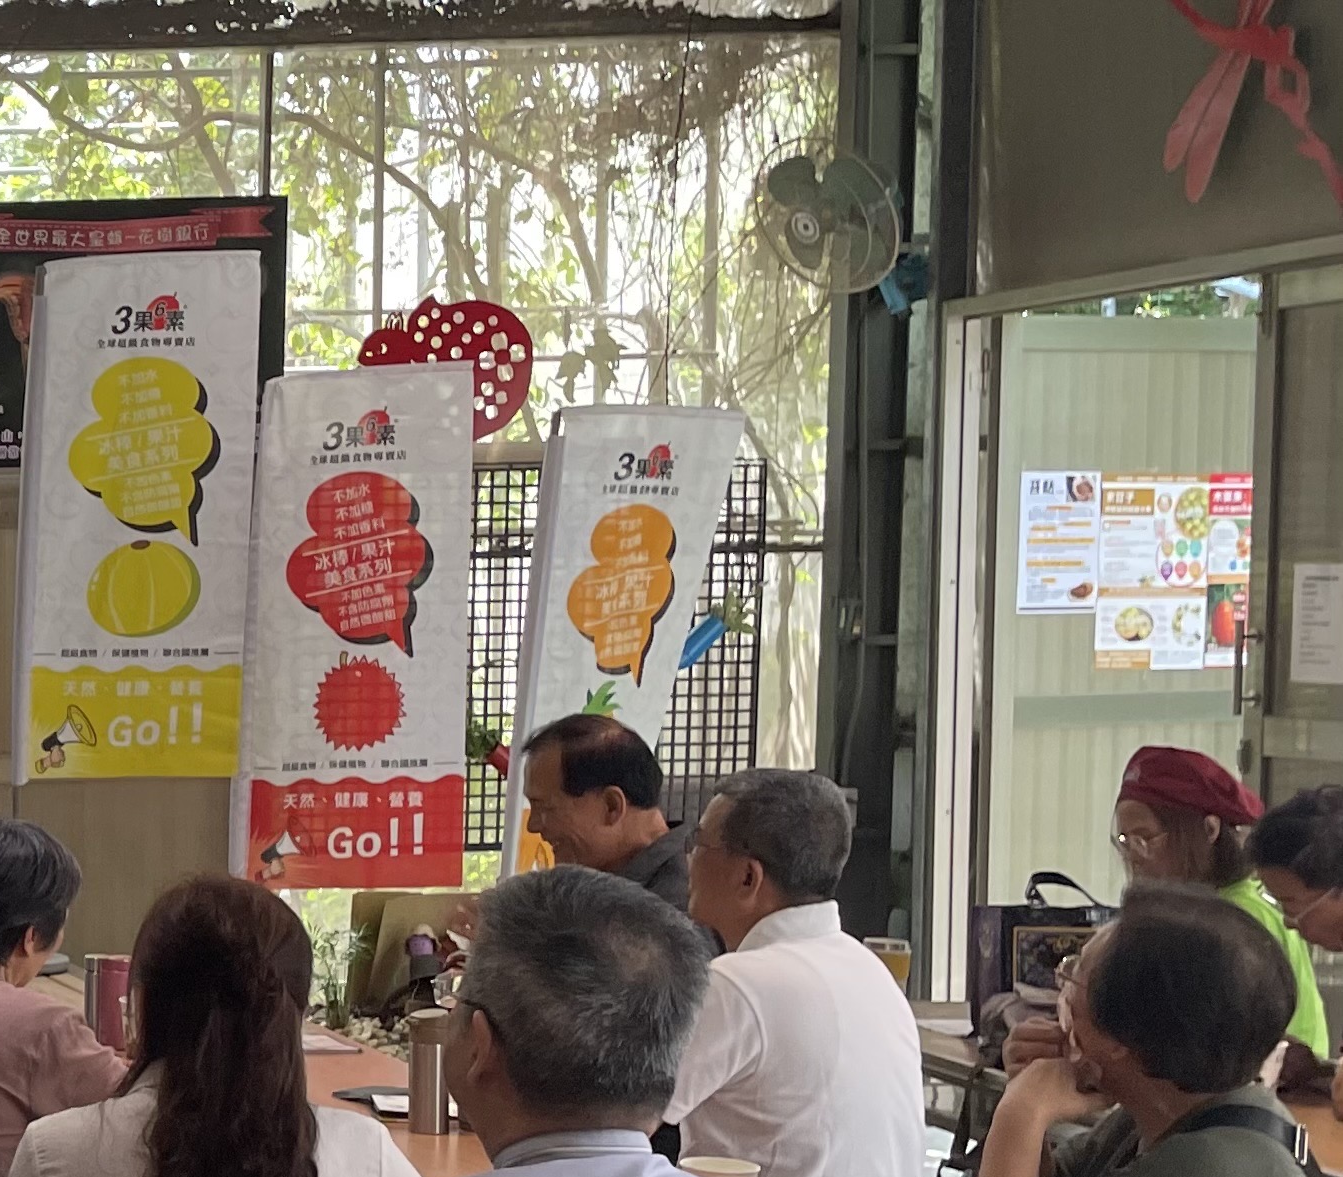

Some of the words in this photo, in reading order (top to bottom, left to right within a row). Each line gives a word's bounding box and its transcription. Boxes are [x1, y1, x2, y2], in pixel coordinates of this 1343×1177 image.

[111, 301, 185, 335] 3果6素
[323, 417, 396, 451] 3果6素
[333, 484, 371, 503] 不加水
[361, 539, 396, 558] 果汁
[324, 556, 392, 588] 美食系列
[107, 702, 204, 748] Go!!
[283, 791, 424, 810] 天然、健康、營養
[327, 812, 424, 859] Go!!
